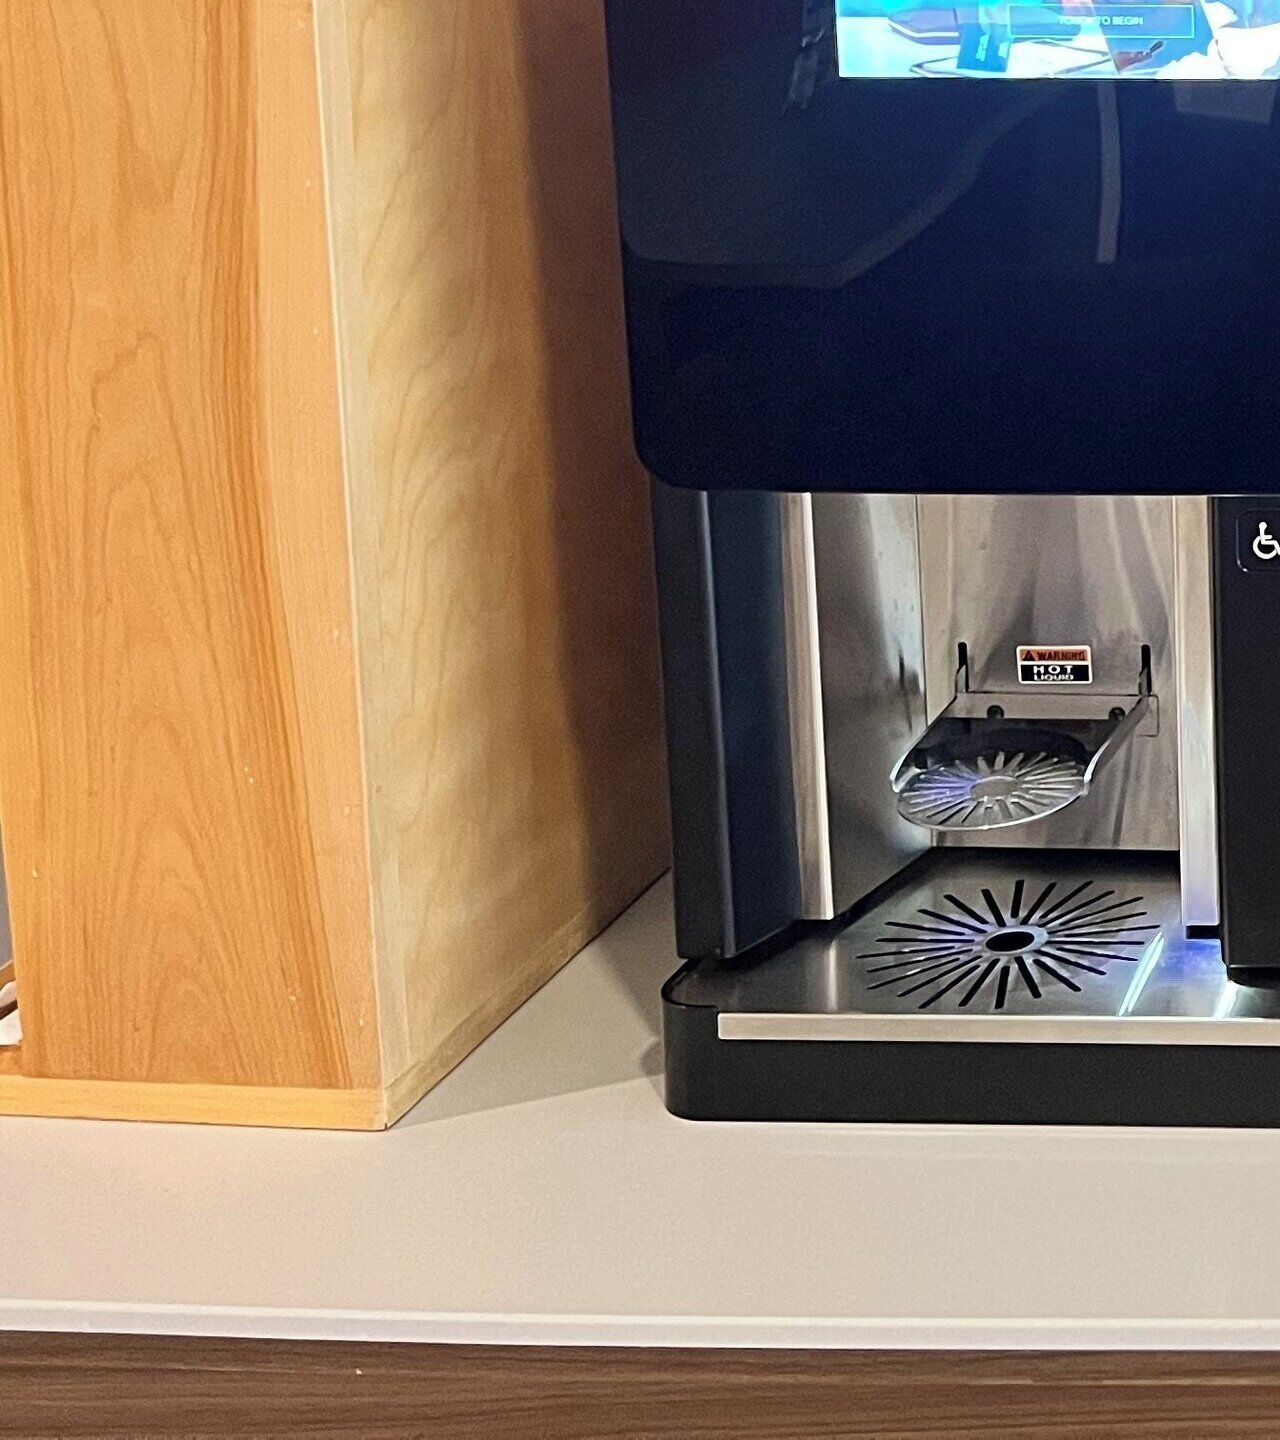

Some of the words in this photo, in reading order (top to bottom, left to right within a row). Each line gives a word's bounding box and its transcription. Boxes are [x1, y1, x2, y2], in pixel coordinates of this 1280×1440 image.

[1036, 650, 1086, 661] WARNING
[1033, 665, 1073, 674] HOT
[1033, 673, 1074, 681] LIQUID
